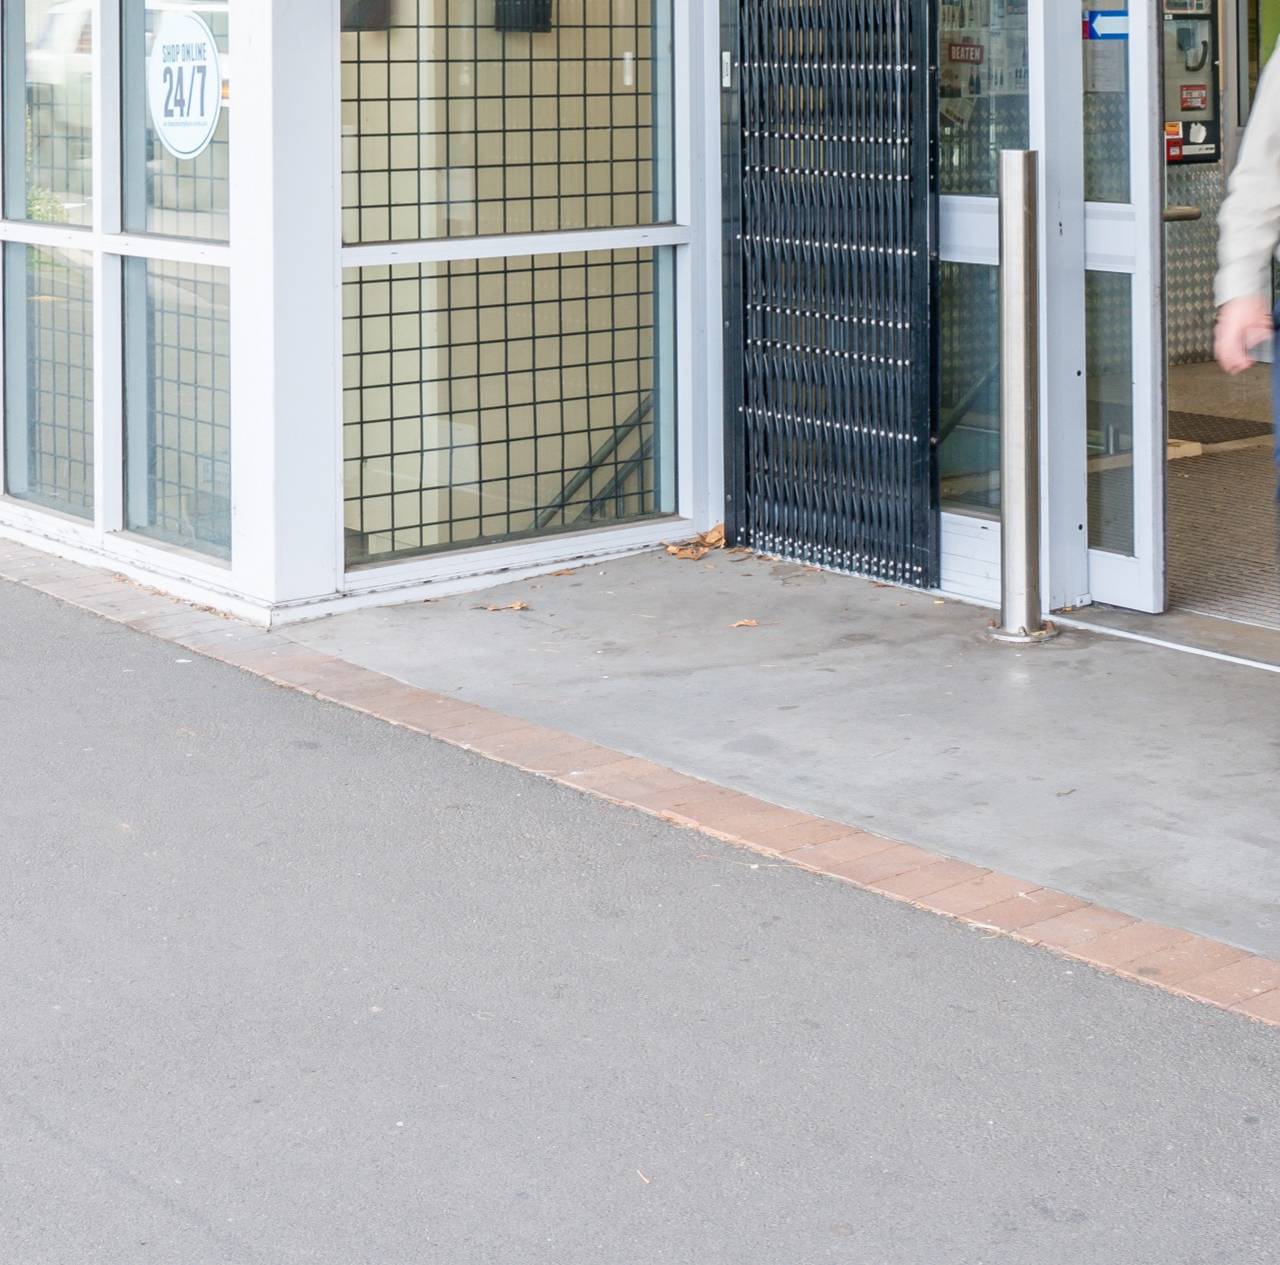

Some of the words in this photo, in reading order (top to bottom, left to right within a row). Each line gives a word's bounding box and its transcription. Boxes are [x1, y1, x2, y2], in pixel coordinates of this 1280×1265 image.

[162, 43, 180, 63] SHOP
[181, 41, 207, 62] ONLINE
[163, 64, 207, 117] 24/7
